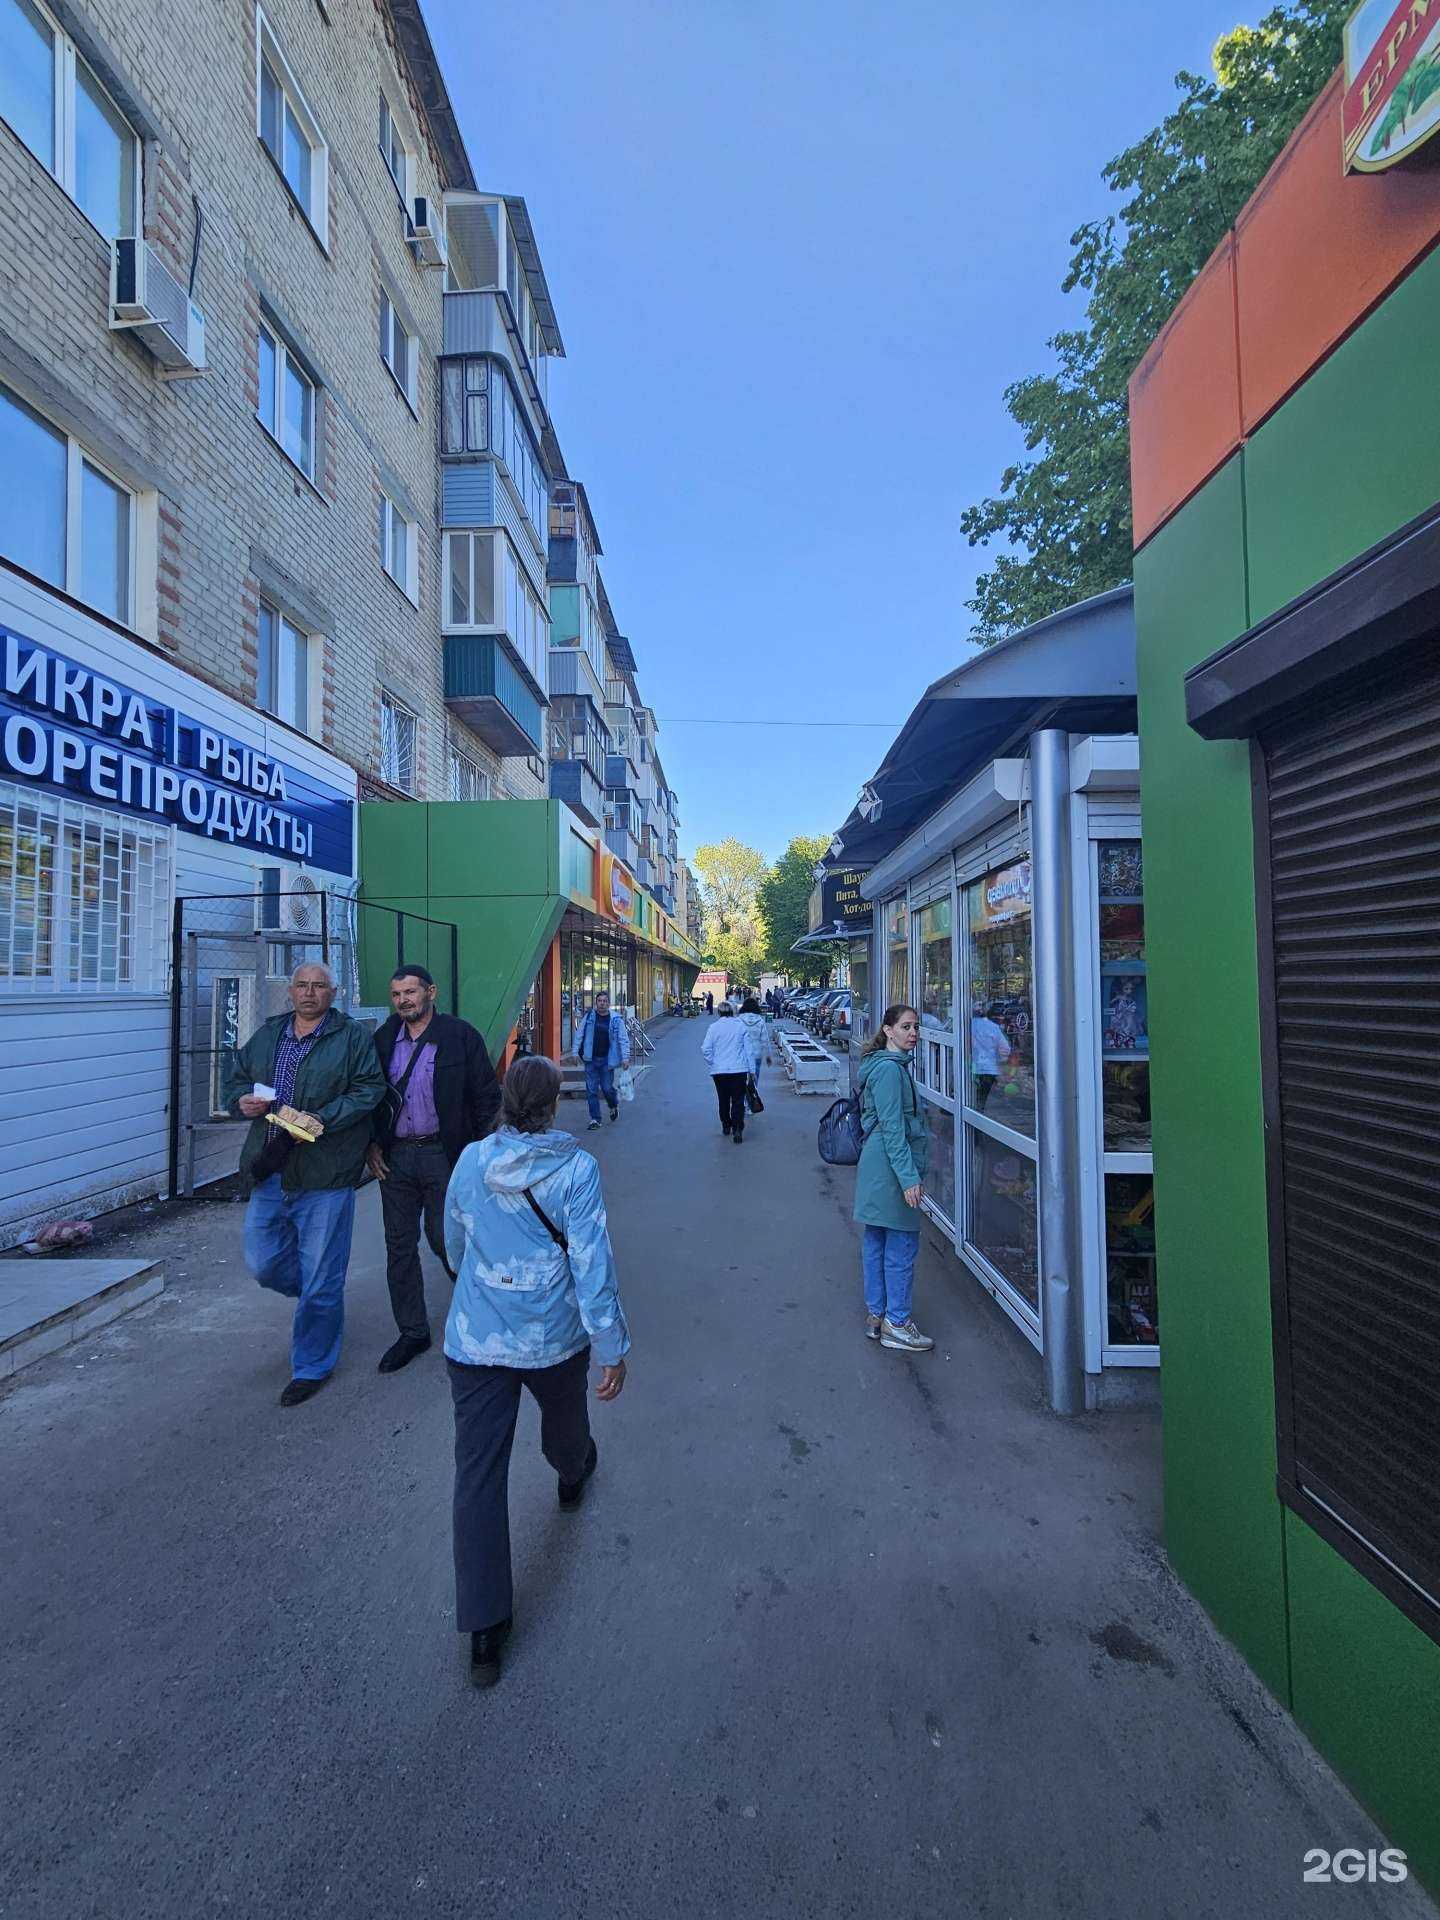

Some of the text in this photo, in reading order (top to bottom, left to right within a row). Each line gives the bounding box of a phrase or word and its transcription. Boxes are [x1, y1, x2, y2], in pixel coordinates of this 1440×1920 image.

[4, 714, 313, 857] ОРЕПРОДУКТЫ
[5, 635, 287, 801] ИКРА РЫБА
[843, 871, 869, 885] Шаур
